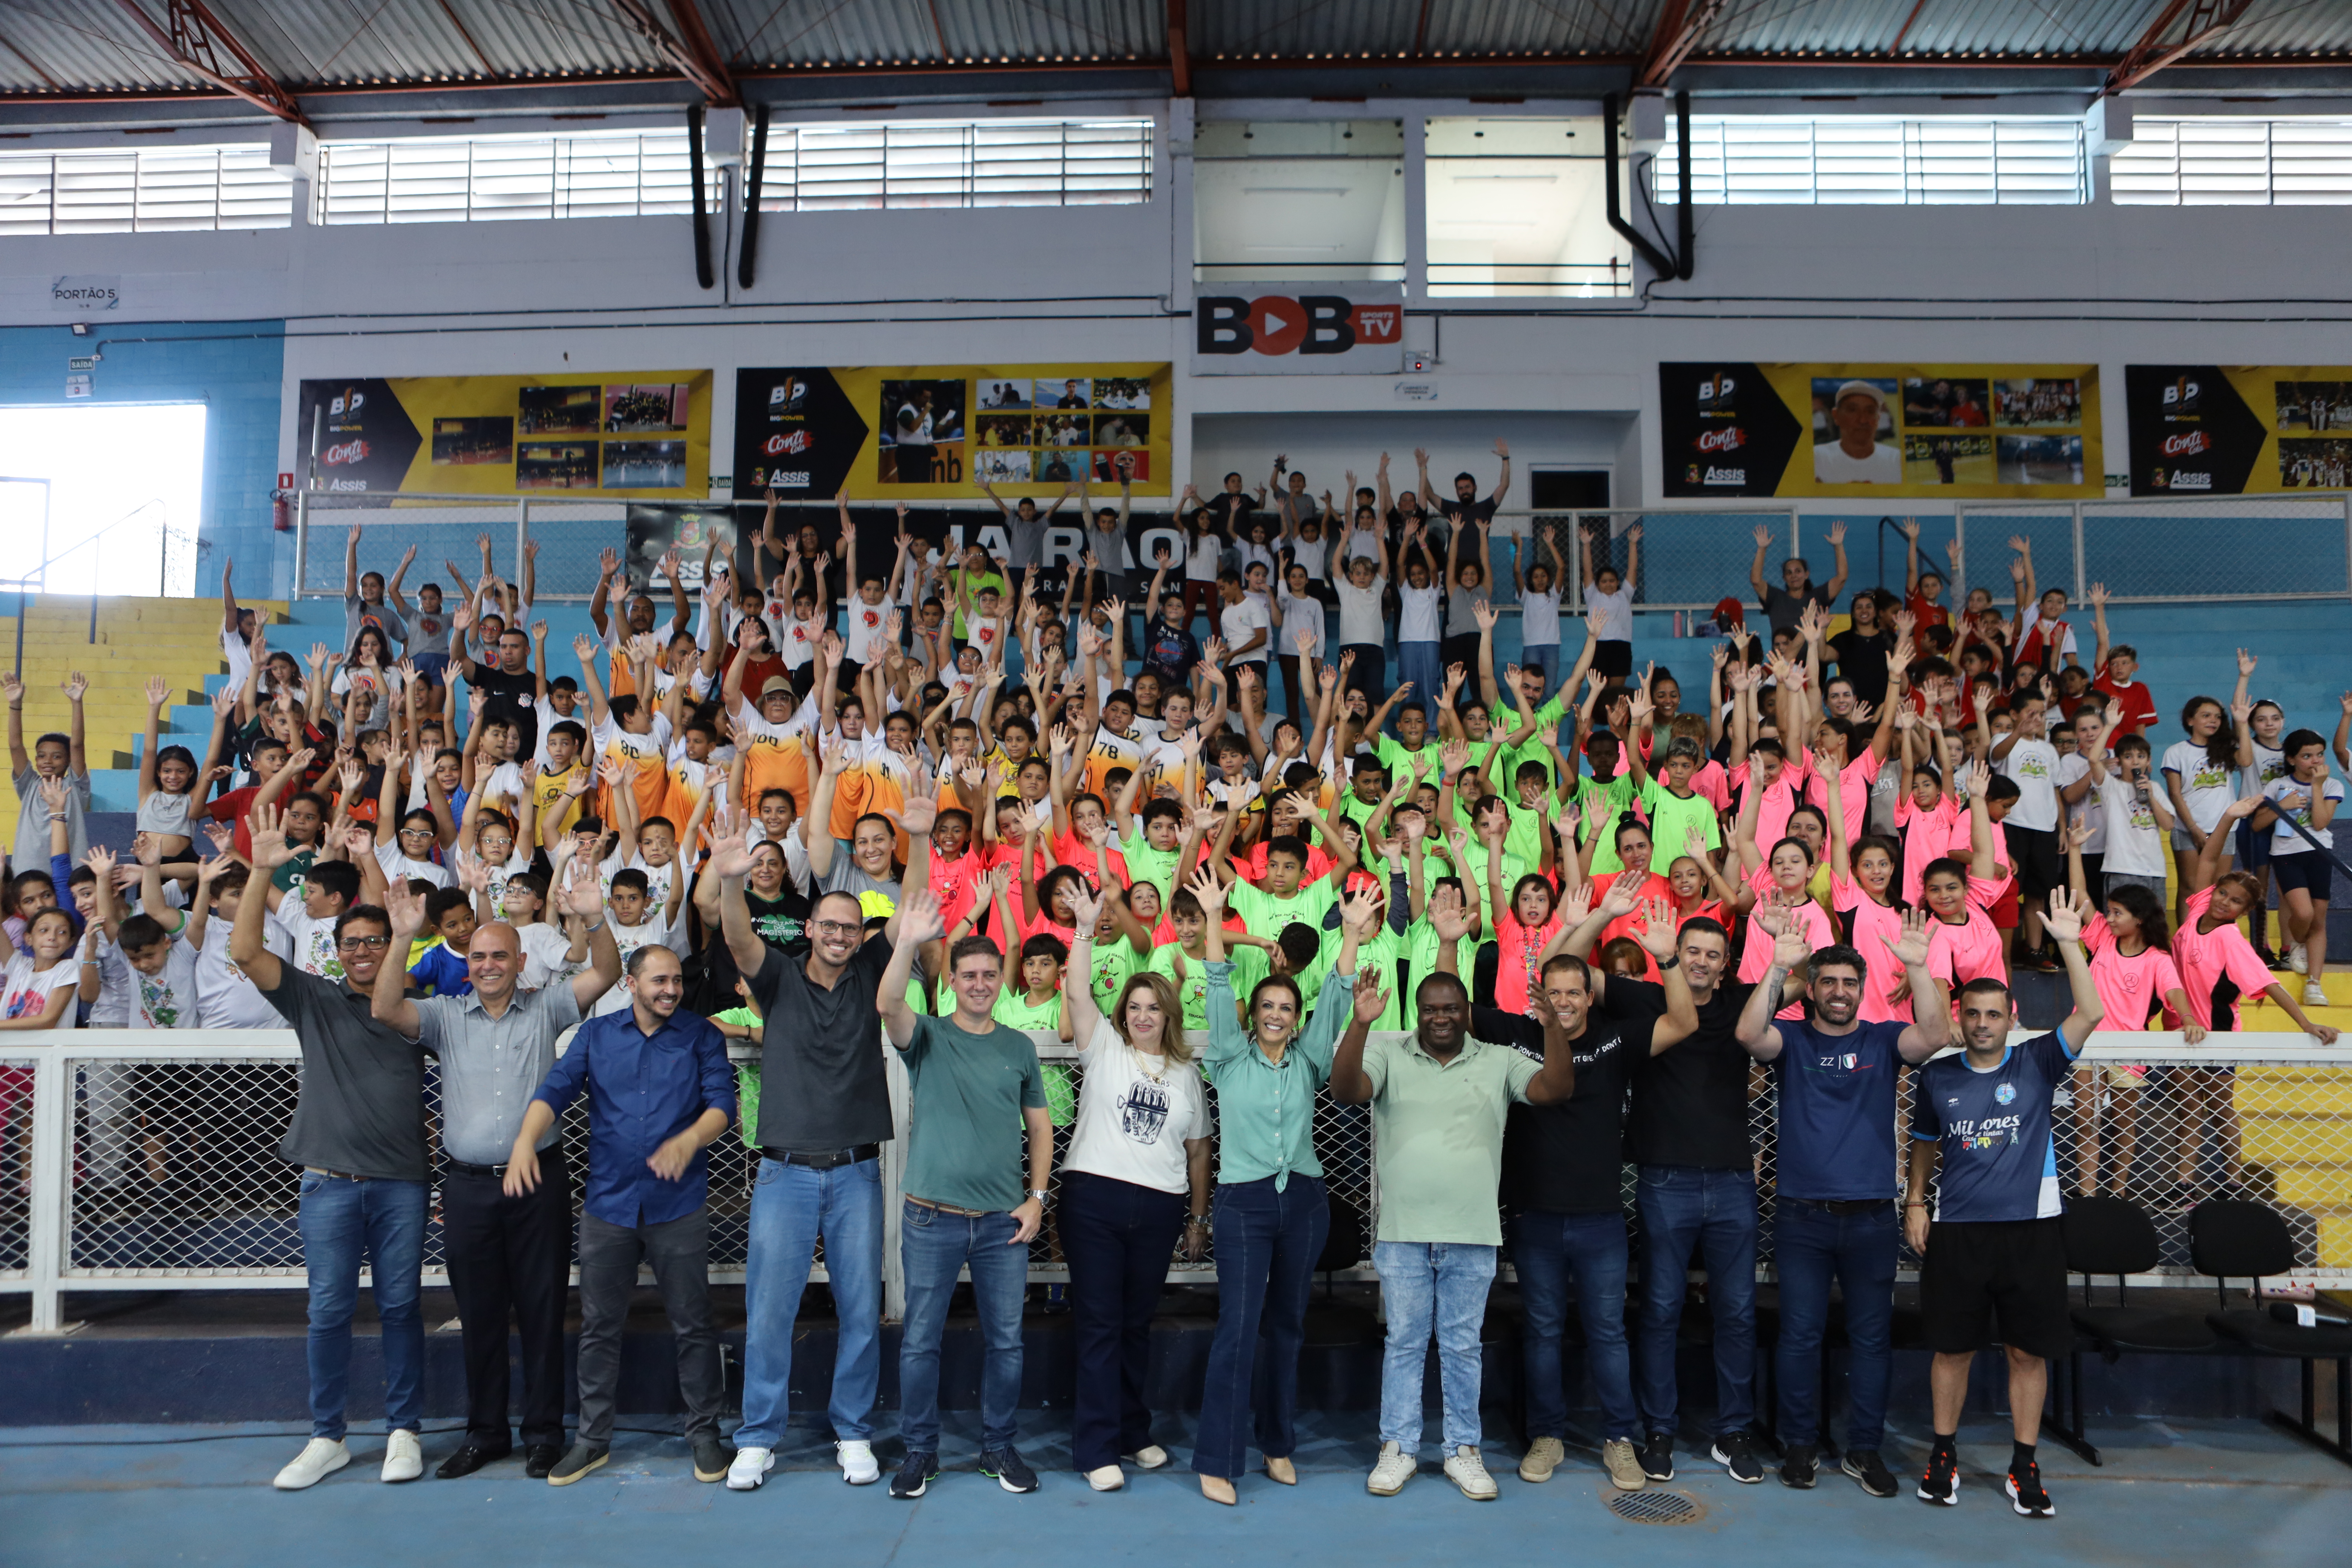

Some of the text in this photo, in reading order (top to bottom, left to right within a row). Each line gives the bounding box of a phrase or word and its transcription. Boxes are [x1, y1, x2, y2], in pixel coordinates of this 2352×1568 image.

[55, 287, 115, 299] PORTÃO 5
[1360, 319, 1393, 336] TV
[767, 429, 805, 453] Conti
[1699, 426, 1736, 449] Conti
[2165, 430, 2202, 453] Conti
[327, 438, 362, 463] Conti
[790, 443, 805, 455] Cola
[718, 478, 731, 486] SAÍDA
[1098, 741, 1118, 760] 78
[750, 917, 805, 926] #VALORIZAÇÃO
[756, 927, 803, 936] MAGISTÉRIO
[1819, 1057, 1834, 1066] ZZ
